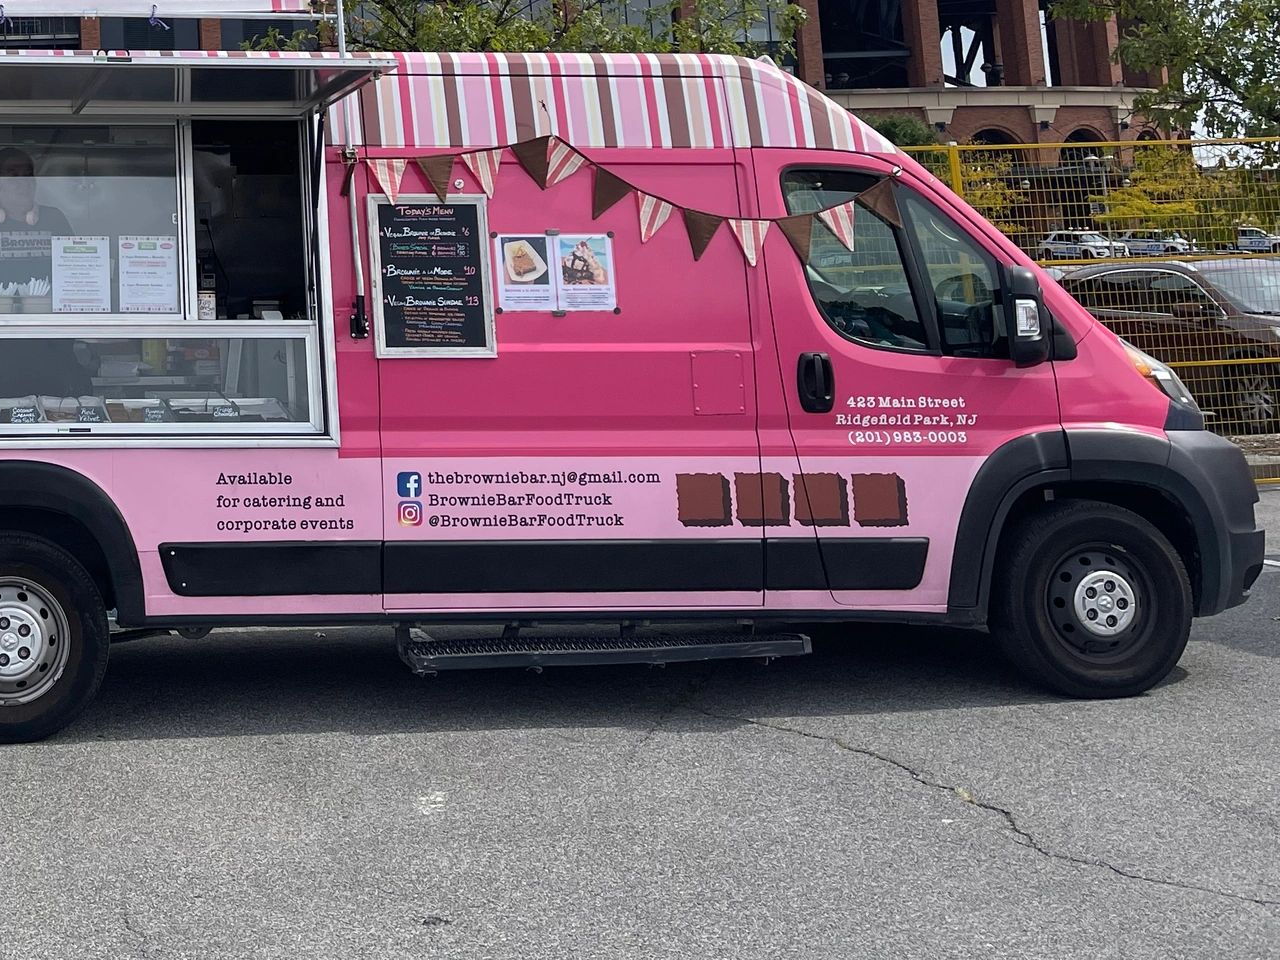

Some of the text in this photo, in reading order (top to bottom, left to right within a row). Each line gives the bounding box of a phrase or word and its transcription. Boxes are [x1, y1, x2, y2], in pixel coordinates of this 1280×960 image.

[847, 396, 966, 408] 423 Main Street
[835, 414, 978, 428] Ridgefield Park, NJ
[847, 431, 968, 445] (201) 983-0003
[216, 472, 293, 486] Available
[427, 471, 662, 488] thebrowniebar.nj@gmail.com
[216, 493, 345, 511] for catering and
[428, 493, 613, 507] BrownieBarFoodTruck
[216, 517, 355, 533] corporate events
[428, 512, 625, 528] @BrownieBarFoodTruck
